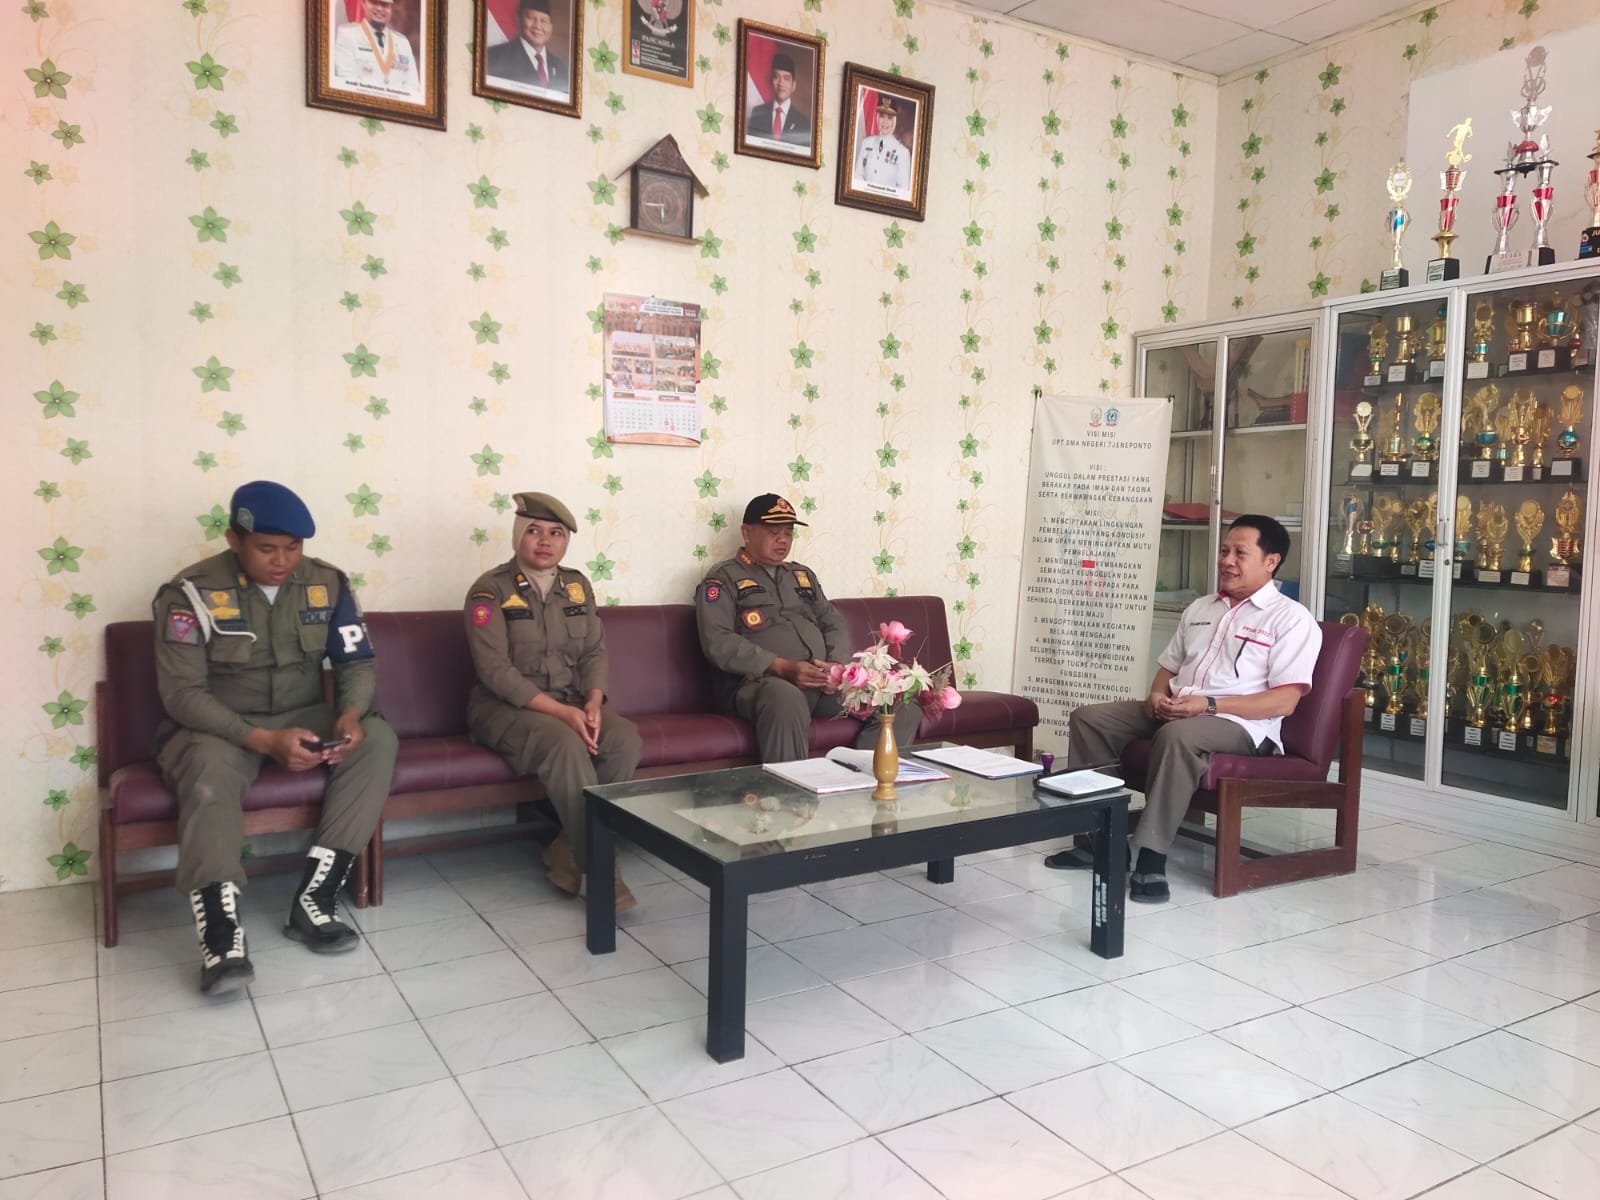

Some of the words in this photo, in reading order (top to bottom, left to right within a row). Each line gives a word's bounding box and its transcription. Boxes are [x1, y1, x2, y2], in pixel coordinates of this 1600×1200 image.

[1087, 430, 1100, 438] VISI
[1102, 430, 1116, 438] MISI
[1082, 440, 1106, 448] NEGERI
[1042, 481, 1071, 489] BERAKAR
[1060, 492, 1106, 501] BERWAWASAN
[1050, 517, 1098, 527] MENCIPTAKAN
[1100, 520, 1144, 528] LINGKUNGAN
[1039, 526, 1090, 536] PEMBELAJARAN
[1112, 531, 1146, 540] KONDUSIF
[1056, 537, 1076, 545] UPAYA
[1079, 539, 1131, 549] MENINGKATKAN
[1064, 548, 1116, 558] PEMBELAJARAN
[1040, 566, 1074, 576] SEMANGAT
[1076, 570, 1121, 579] KEUNGGULAN
[1036, 576, 1070, 585] BERNALAR
[1072, 579, 1092, 587] SEHAT
[1094, 582, 1120, 590] KEPADA
[1028, 586, 1053, 594] PESERTA
[1026, 596, 1057, 604] SEHINGGA
[1059, 598, 1104, 608] BERKEMAUAN
[1105, 602, 1122, 610] KUAT
[1064, 608, 1084, 616] TERUS
[1040, 617, 1100, 628] MENGOPTIMALKAN
[1102, 622, 1136, 631] KEGIATAN
[1050, 628, 1078, 637] BELAJAR
[1080, 631, 1116, 640] MENGAJAR
[1042, 638, 1093, 648] MENINGKATKAN
[1094, 642, 1131, 651] KOMITMEN
[1030, 646, 1056, 655] SELURUH
[1058, 648, 1084, 658] TENAGA
[1034, 656, 1065, 666] TERHADAP
[1068, 660, 1088, 668] TUGAS
[1090, 662, 1112, 670] POKOK
[1060, 670, 1097, 680] FUNGSINYA
[1036, 676, 1092, 689] MENGEMBANGKAN
[1094, 683, 1132, 693] TEKNOLOGI
[1022, 685, 1056, 695] INFORMASI
[1056, 689, 1069, 697] DAN
[1070, 691, 1112, 702] KOMUNIKASI
